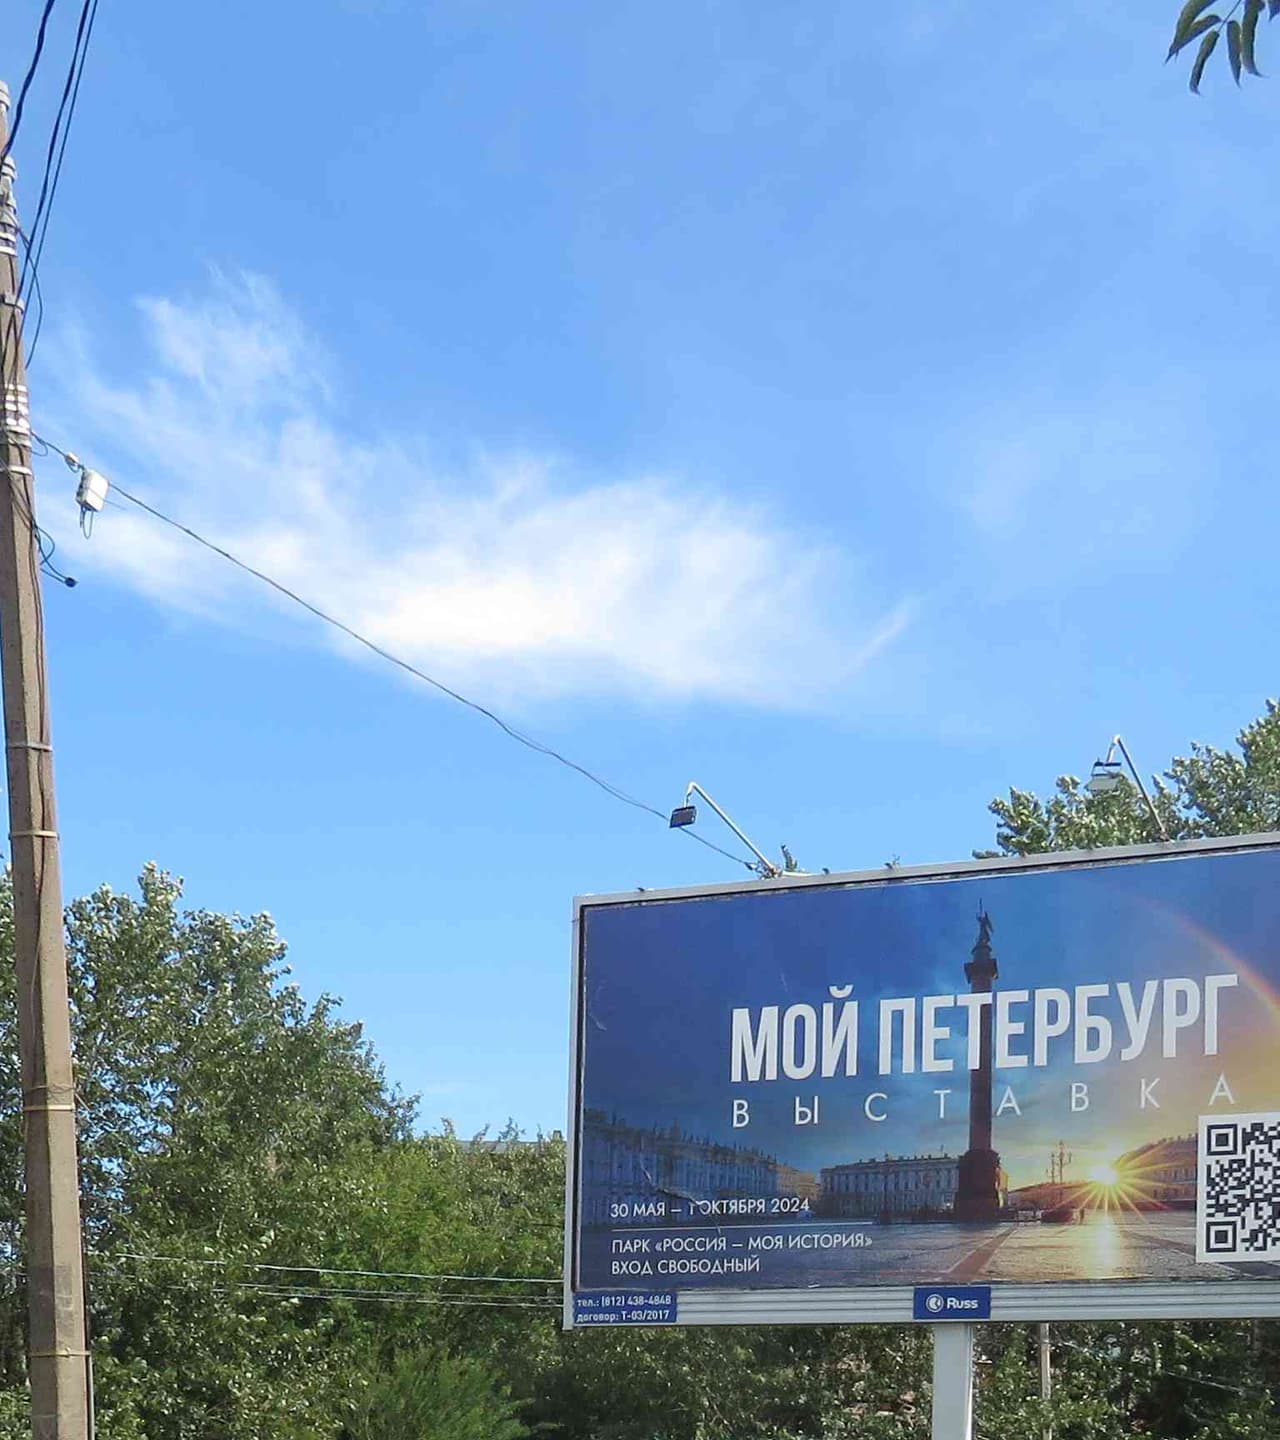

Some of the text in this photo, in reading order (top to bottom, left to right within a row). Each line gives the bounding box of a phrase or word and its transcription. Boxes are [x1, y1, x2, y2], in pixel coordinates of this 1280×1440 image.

[730, 973, 1238, 1082] МОЙ ПЕТЕРБУРГ
[732, 1074, 1236, 1127] ВЫСТАВКА
[610, 1203, 629, 1218] 30
[632, 1202, 666, 1217] МАЯ
[699, 1199, 766, 1215] ОКТЯБРЯ
[770, 1197, 810, 1213] 2024
[611, 1239, 651, 1254] ПАРК
[654, 1237, 727, 1253] «РОССИЯ
[748, 1235, 784, 1250] МОЯ
[788, 1233, 873, 1249] ИСТОРИЯ»
[611, 1254, 761, 1275] ВХОД СВОБОДНЫЙ
[576, 1298, 600, 1308] тел.:
[601, 1295, 625, 1308] (812)
[946, 1297, 979, 1310] Russ
[576, 1311, 619, 1323] договор:
